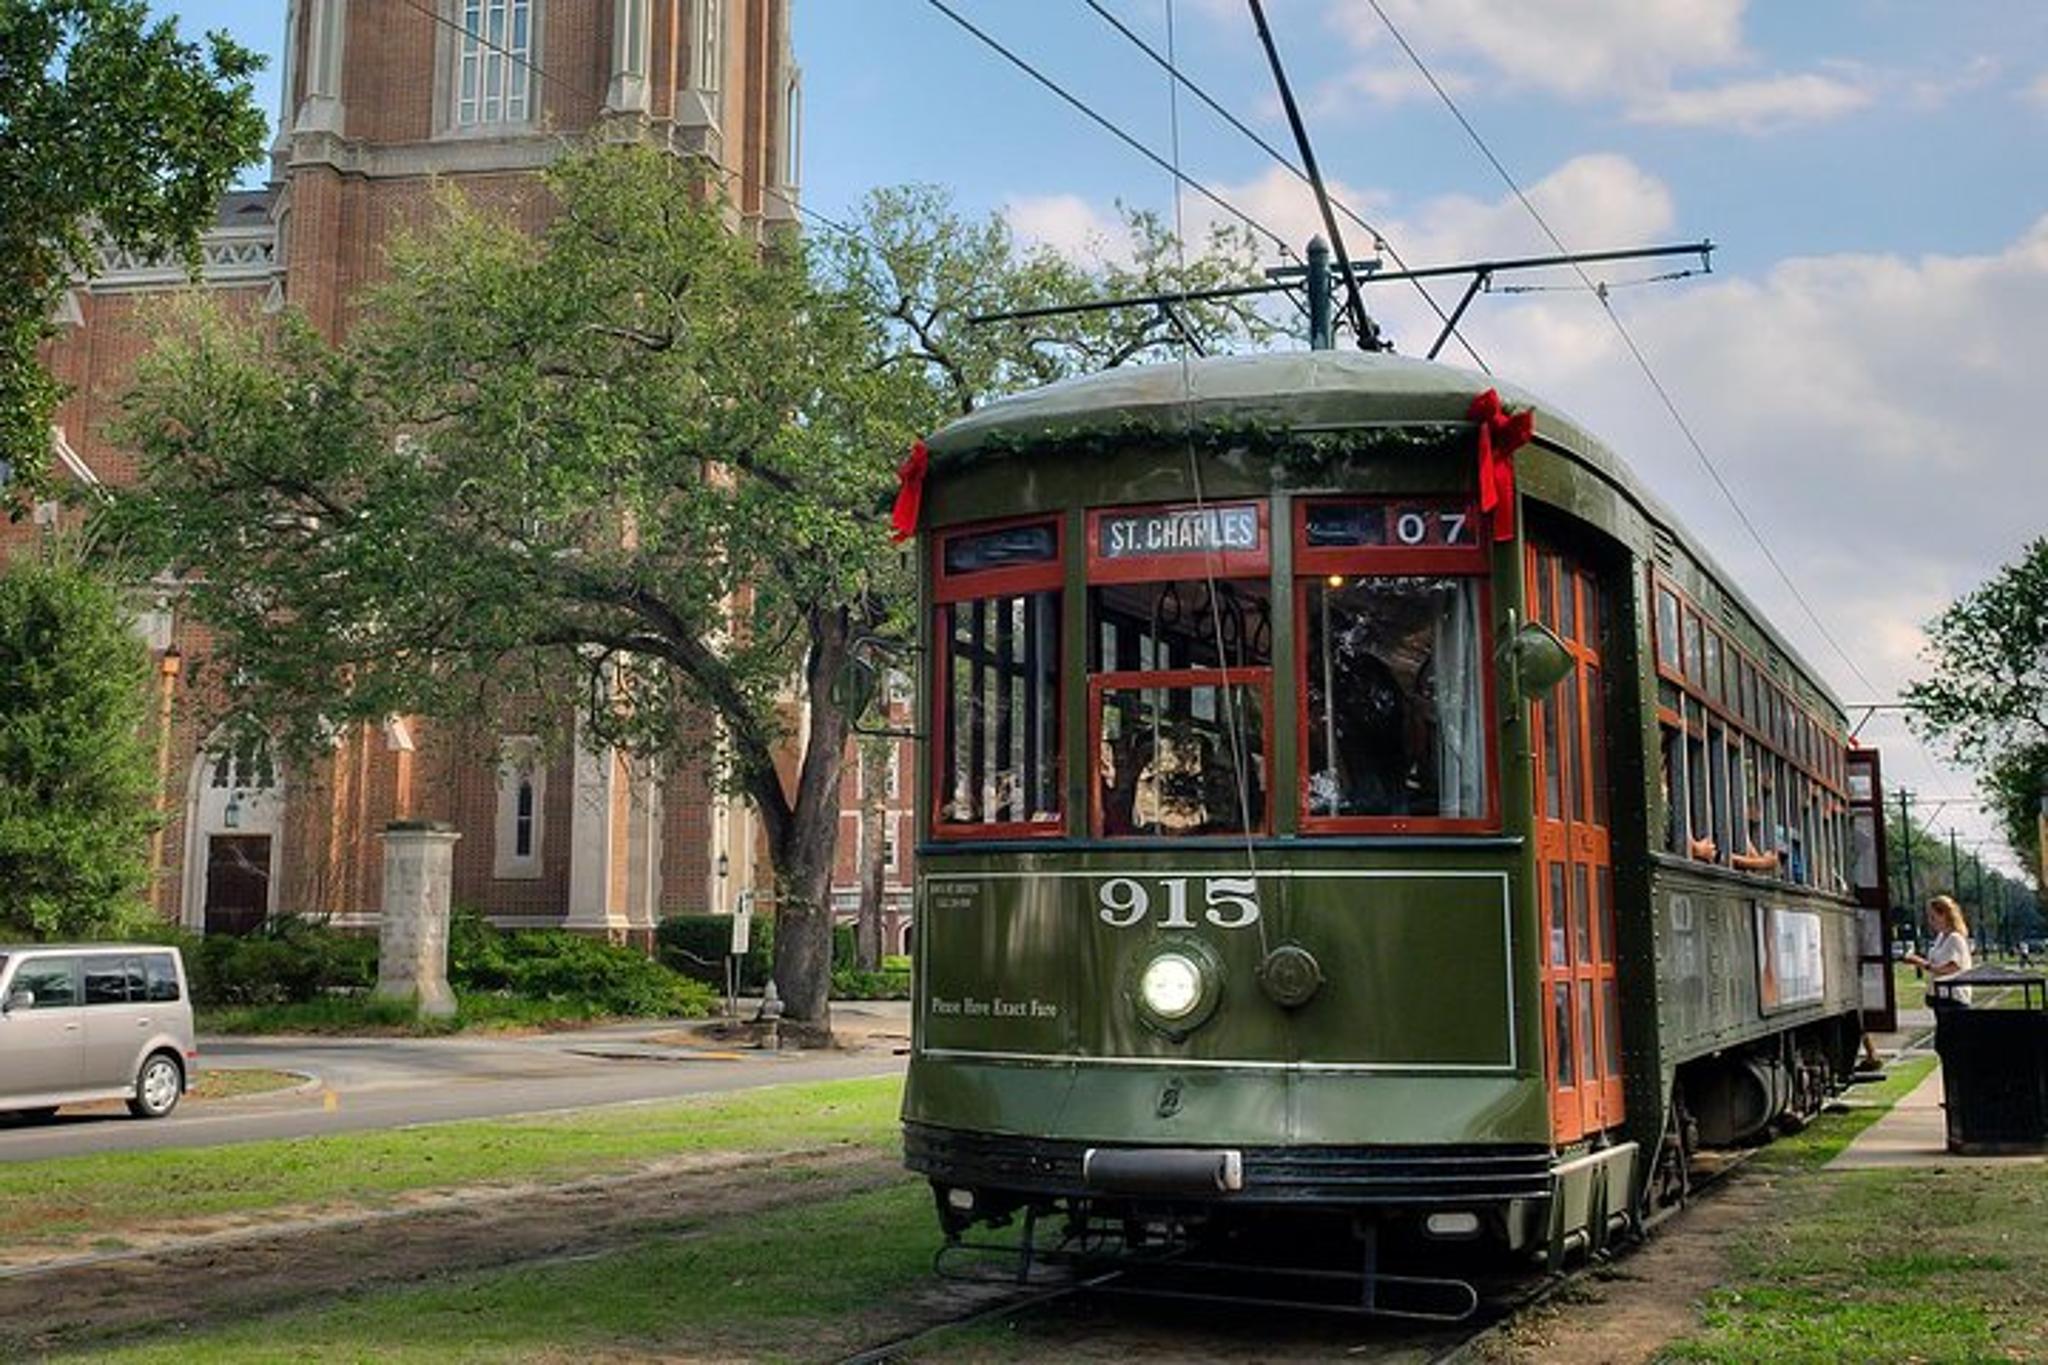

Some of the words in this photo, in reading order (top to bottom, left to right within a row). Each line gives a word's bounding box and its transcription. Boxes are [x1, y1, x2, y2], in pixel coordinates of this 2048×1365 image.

[1111, 520, 1142, 550] ST.
[1147, 514, 1253, 549] CHARLES
[1099, 878, 1260, 928] 915
[993, 998, 1026, 1016] Exact
